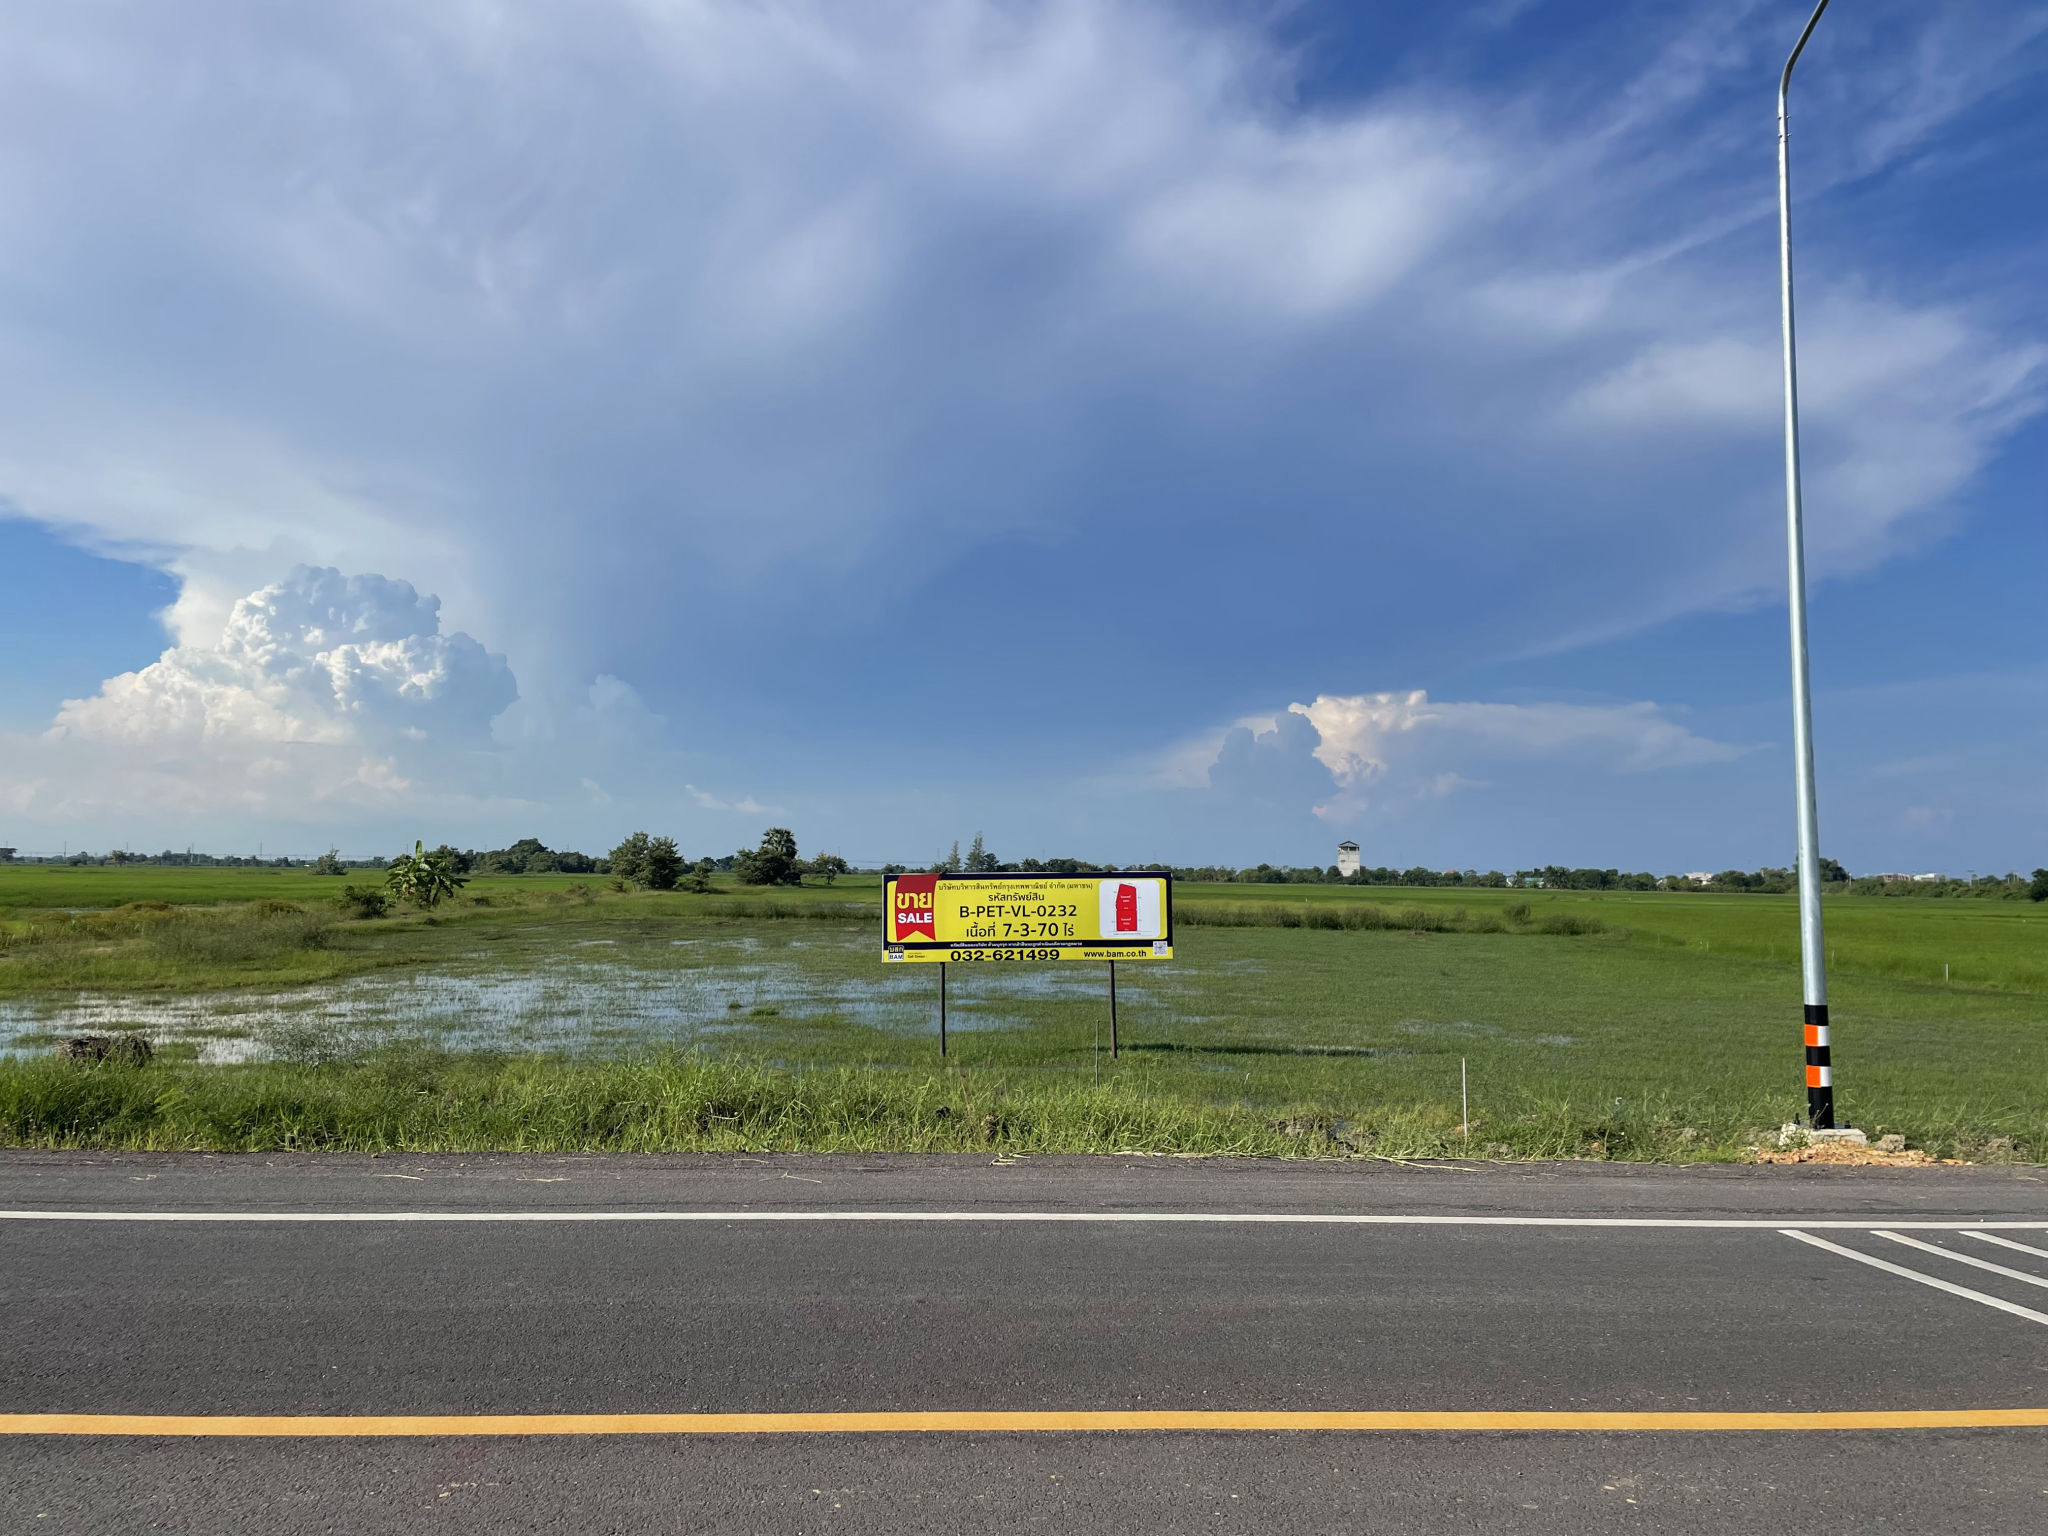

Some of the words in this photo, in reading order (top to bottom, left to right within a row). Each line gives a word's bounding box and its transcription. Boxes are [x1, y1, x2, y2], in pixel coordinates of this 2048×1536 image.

[896, 892, 932, 909] ขาย
[988, 892, 1045, 903] รหัสทรัพย์สิน
[960, 905, 1077, 918] B-PET-VL-0232
[897, 912, 933, 924] SALE
[966, 921, 996, 938] เนื้อที่
[1003, 922, 1059, 938] 7-3-70
[1063, 922, 1075, 937] ไร่
[950, 949, 1060, 961] 032-621499
[1084, 950, 1147, 958] www.bam.co.th
